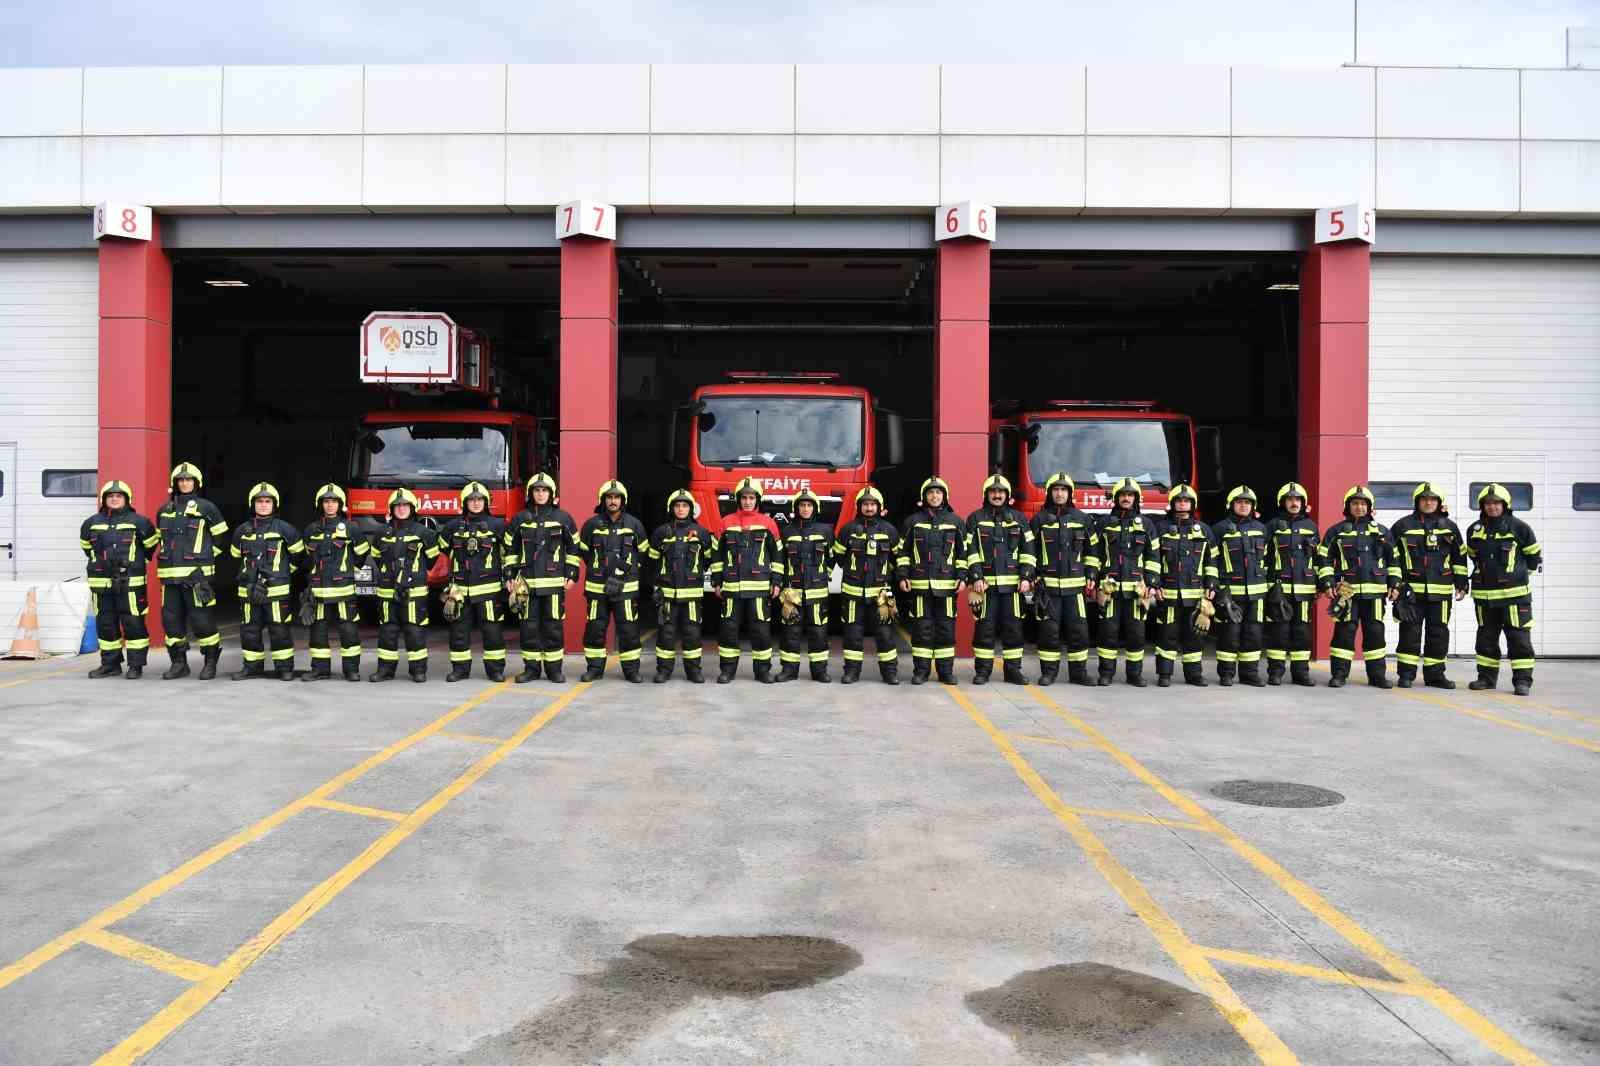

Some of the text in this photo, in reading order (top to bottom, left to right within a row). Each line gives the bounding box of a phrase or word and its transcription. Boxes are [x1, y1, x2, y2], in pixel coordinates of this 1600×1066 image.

[98, 209, 103, 232] 8
[121, 208, 137, 233] 8
[563, 206, 573, 233] 7
[592, 206, 604, 232] 7
[946, 207, 959, 233] 6
[978, 208, 987, 233] 6
[1329, 209, 1345, 236] 5
[1363, 211, 1370, 236] 5
[760, 476, 811, 490] FAİYE
